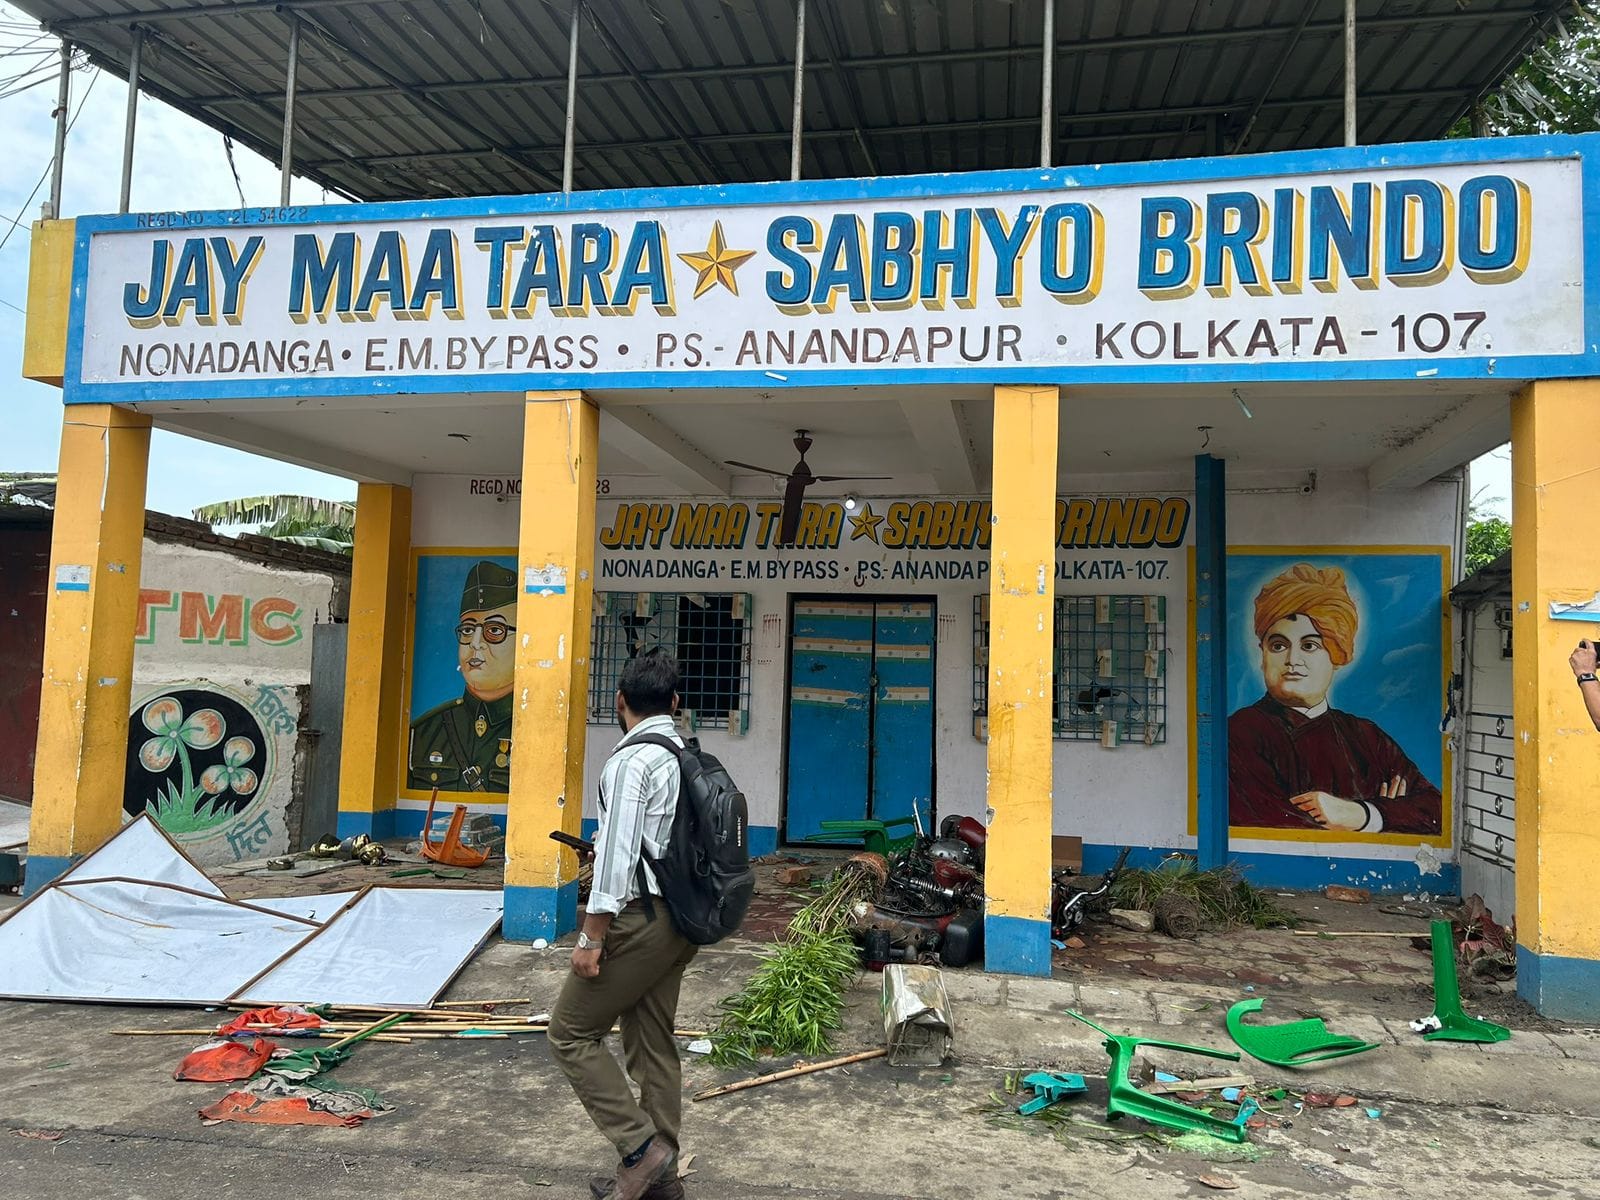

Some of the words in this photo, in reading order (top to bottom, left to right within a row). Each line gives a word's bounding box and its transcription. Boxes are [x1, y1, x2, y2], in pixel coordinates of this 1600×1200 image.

[137, 212, 177, 228] REGD
[123, 236, 266, 330] JAY
[288, 228, 466, 325] MAA
[474, 220, 678, 318] TARA
[765, 202, 1106, 317] SABHYO
[1137, 174, 1533, 301] BRINDO
[119, 339, 335, 377] NONADANGA
[735, 324, 1023, 366] ANANDAPUR
[470, 479, 503, 495] REGD
[600, 503, 674, 550] JAY
[671, 502, 750, 550] MAA
[756, 502, 846, 550] TRA
[882, 501, 992, 550] SABHY
[602, 558, 719, 579] NONADANGA
[891, 560, 989, 580] ANANDAP
[225, 811, 273, 862] দিন
